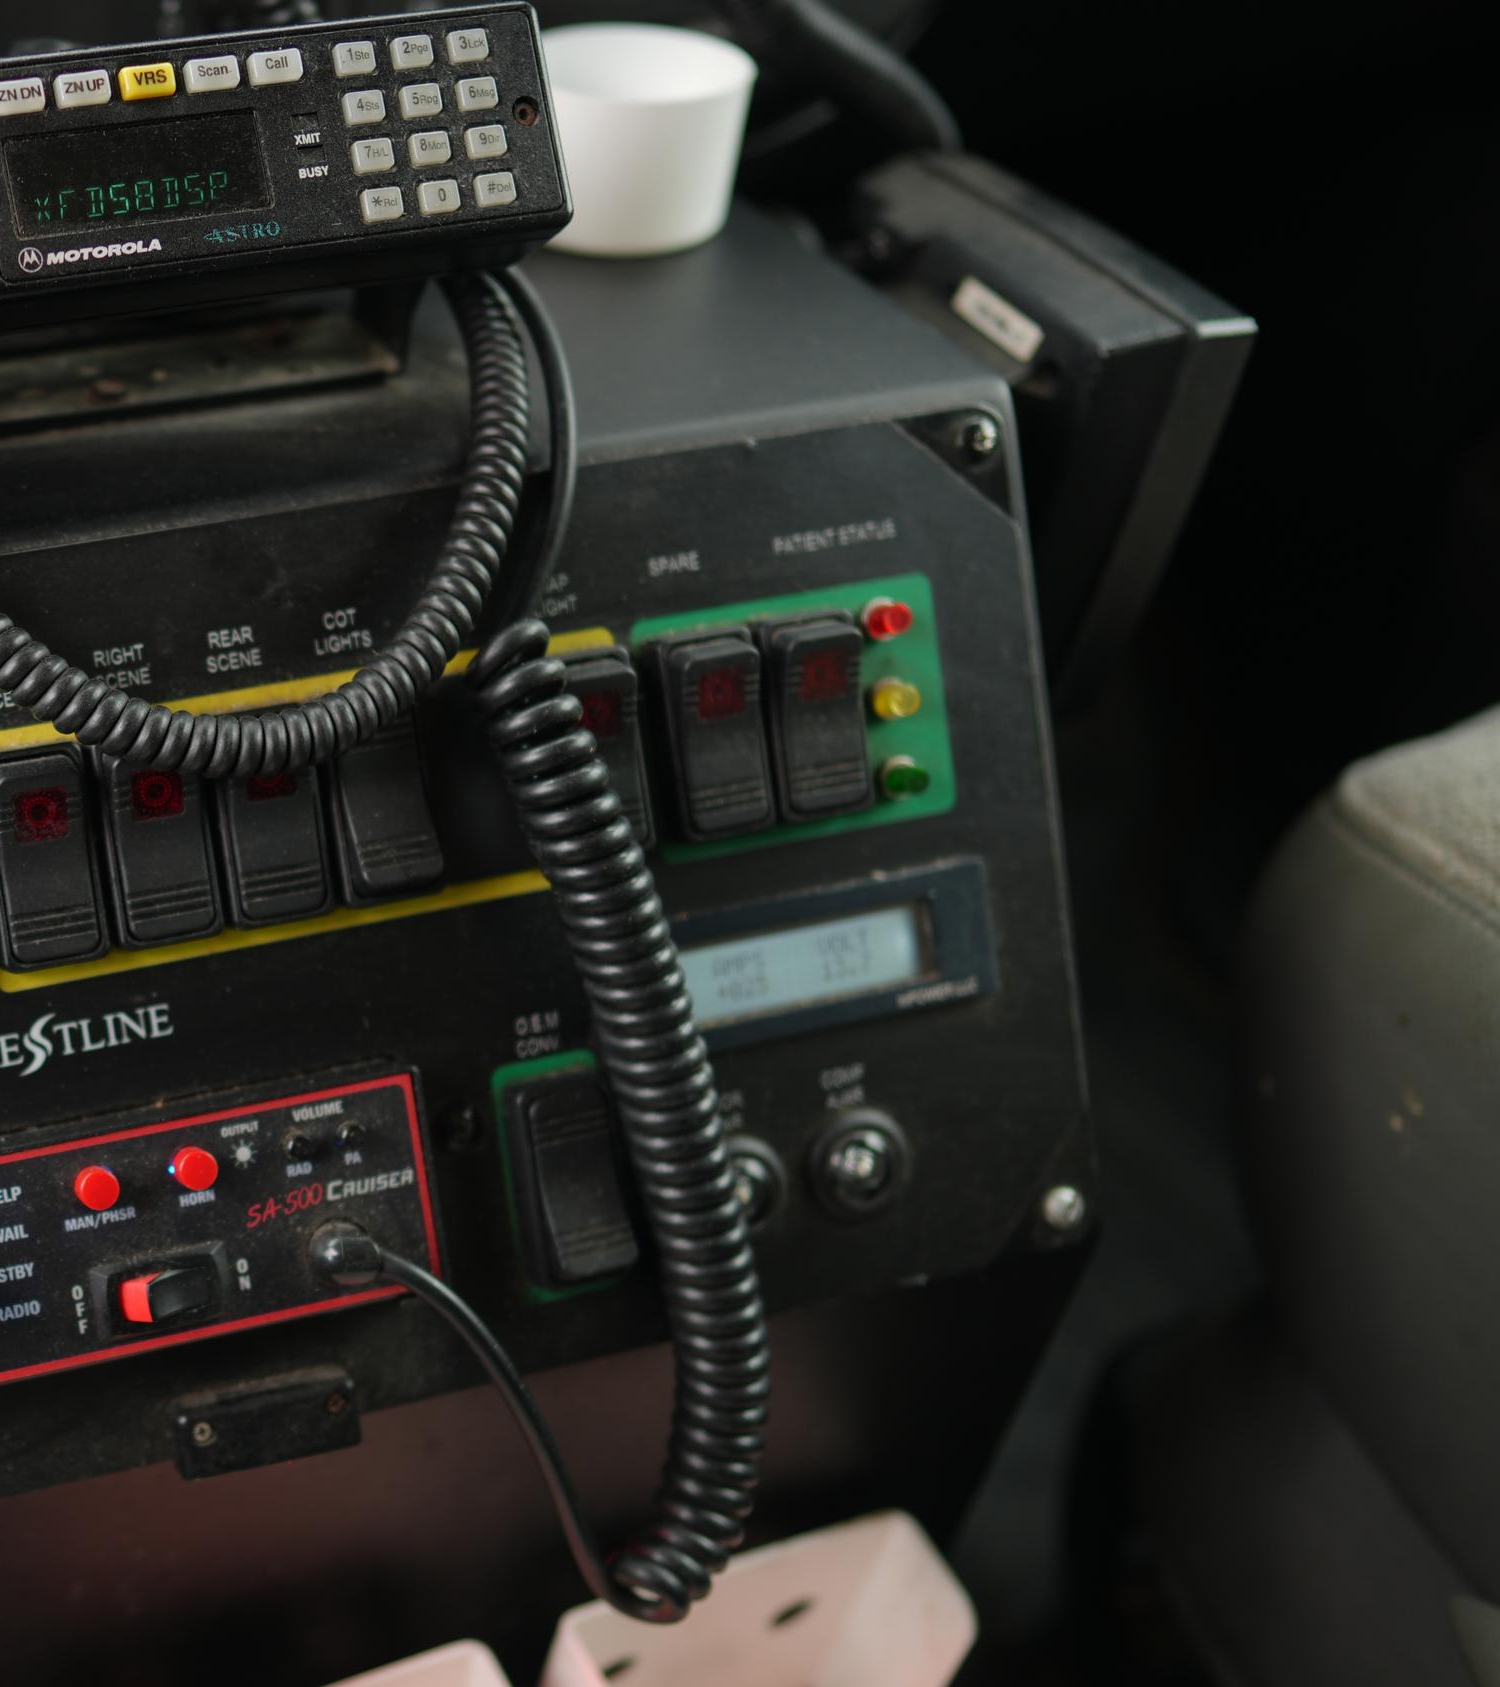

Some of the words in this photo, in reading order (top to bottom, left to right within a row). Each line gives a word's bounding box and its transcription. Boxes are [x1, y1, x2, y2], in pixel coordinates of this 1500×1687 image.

[197, 63, 229, 78] Scan
[265, 55, 289, 70] Call
[65, 81, 83, 95] ZN
[84, 78, 105, 92] UP
[133, 69, 167, 86] VRS
[20, 85, 41, 100] DN
[294, 132, 321, 146] XMIT
[299, 165, 329, 179] BUSY
[438, 188, 446, 202] 0
[204, 221, 281, 243] ASTRO
[47, 239, 162, 265] MOTOROLA
[771, 527, 835, 556] PATIENT
[648, 550, 700, 577] SPARE
[323, 607, 356, 630] COT
[207, 625, 253, 649] REAR
[315, 630, 373, 656] LIGHTS
[93, 643, 145, 668] RIGHT
[206, 648, 262, 673] SCENE
[97, 667, 152, 690] CENE
[292, 1100, 344, 1122] VOLUME
[220, 1120, 259, 1138] OUTPUT
[344, 1151, 363, 1166] PA
[286, 1162, 313, 1178] RAD
[179, 1189, 216, 1208] HORN
[246, 1183, 324, 1229] SA-500
[65, 1206, 136, 1233] MAN/PHSR
[72, 1285, 88, 1334] OFF
